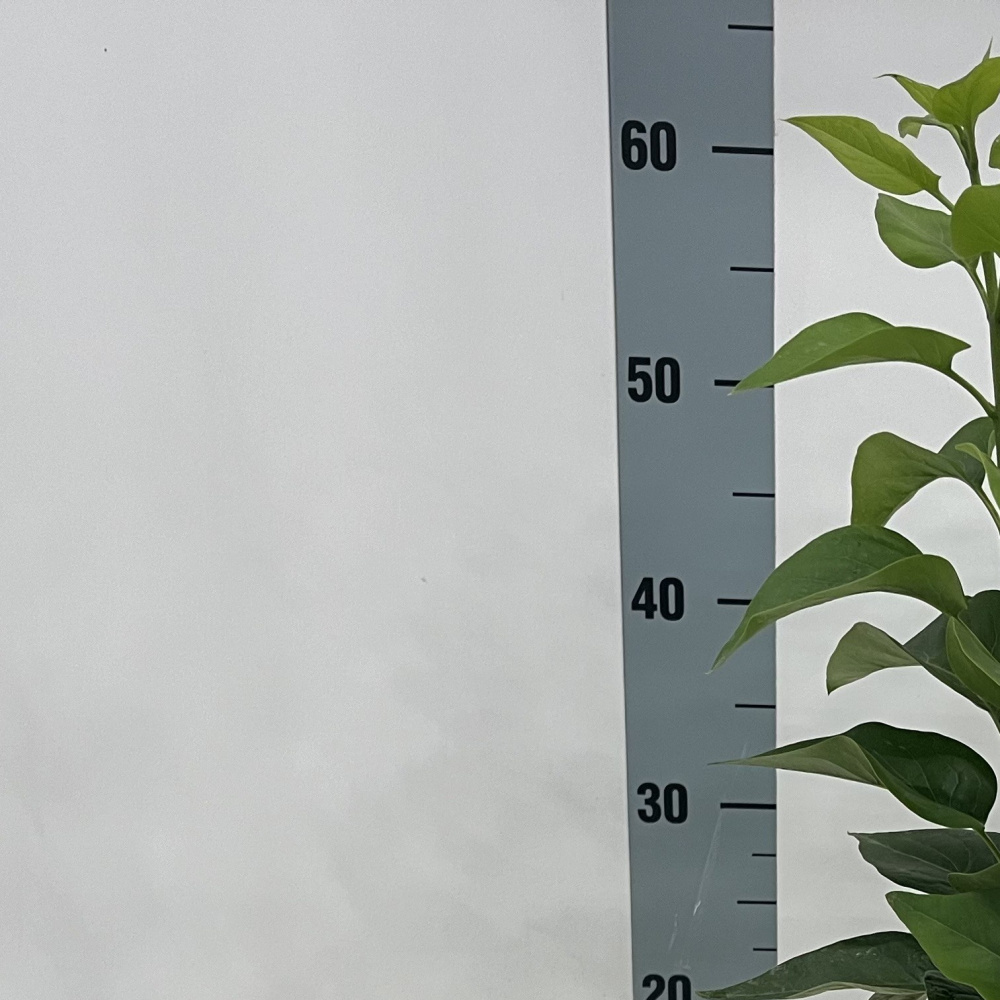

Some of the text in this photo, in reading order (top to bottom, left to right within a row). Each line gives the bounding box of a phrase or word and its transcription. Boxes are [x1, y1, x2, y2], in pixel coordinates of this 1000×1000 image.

[621, 120, 677, 171] 60
[627, 356, 681, 404] 50
[631, 577, 685, 621] 40
[637, 782, 688, 824] 30
